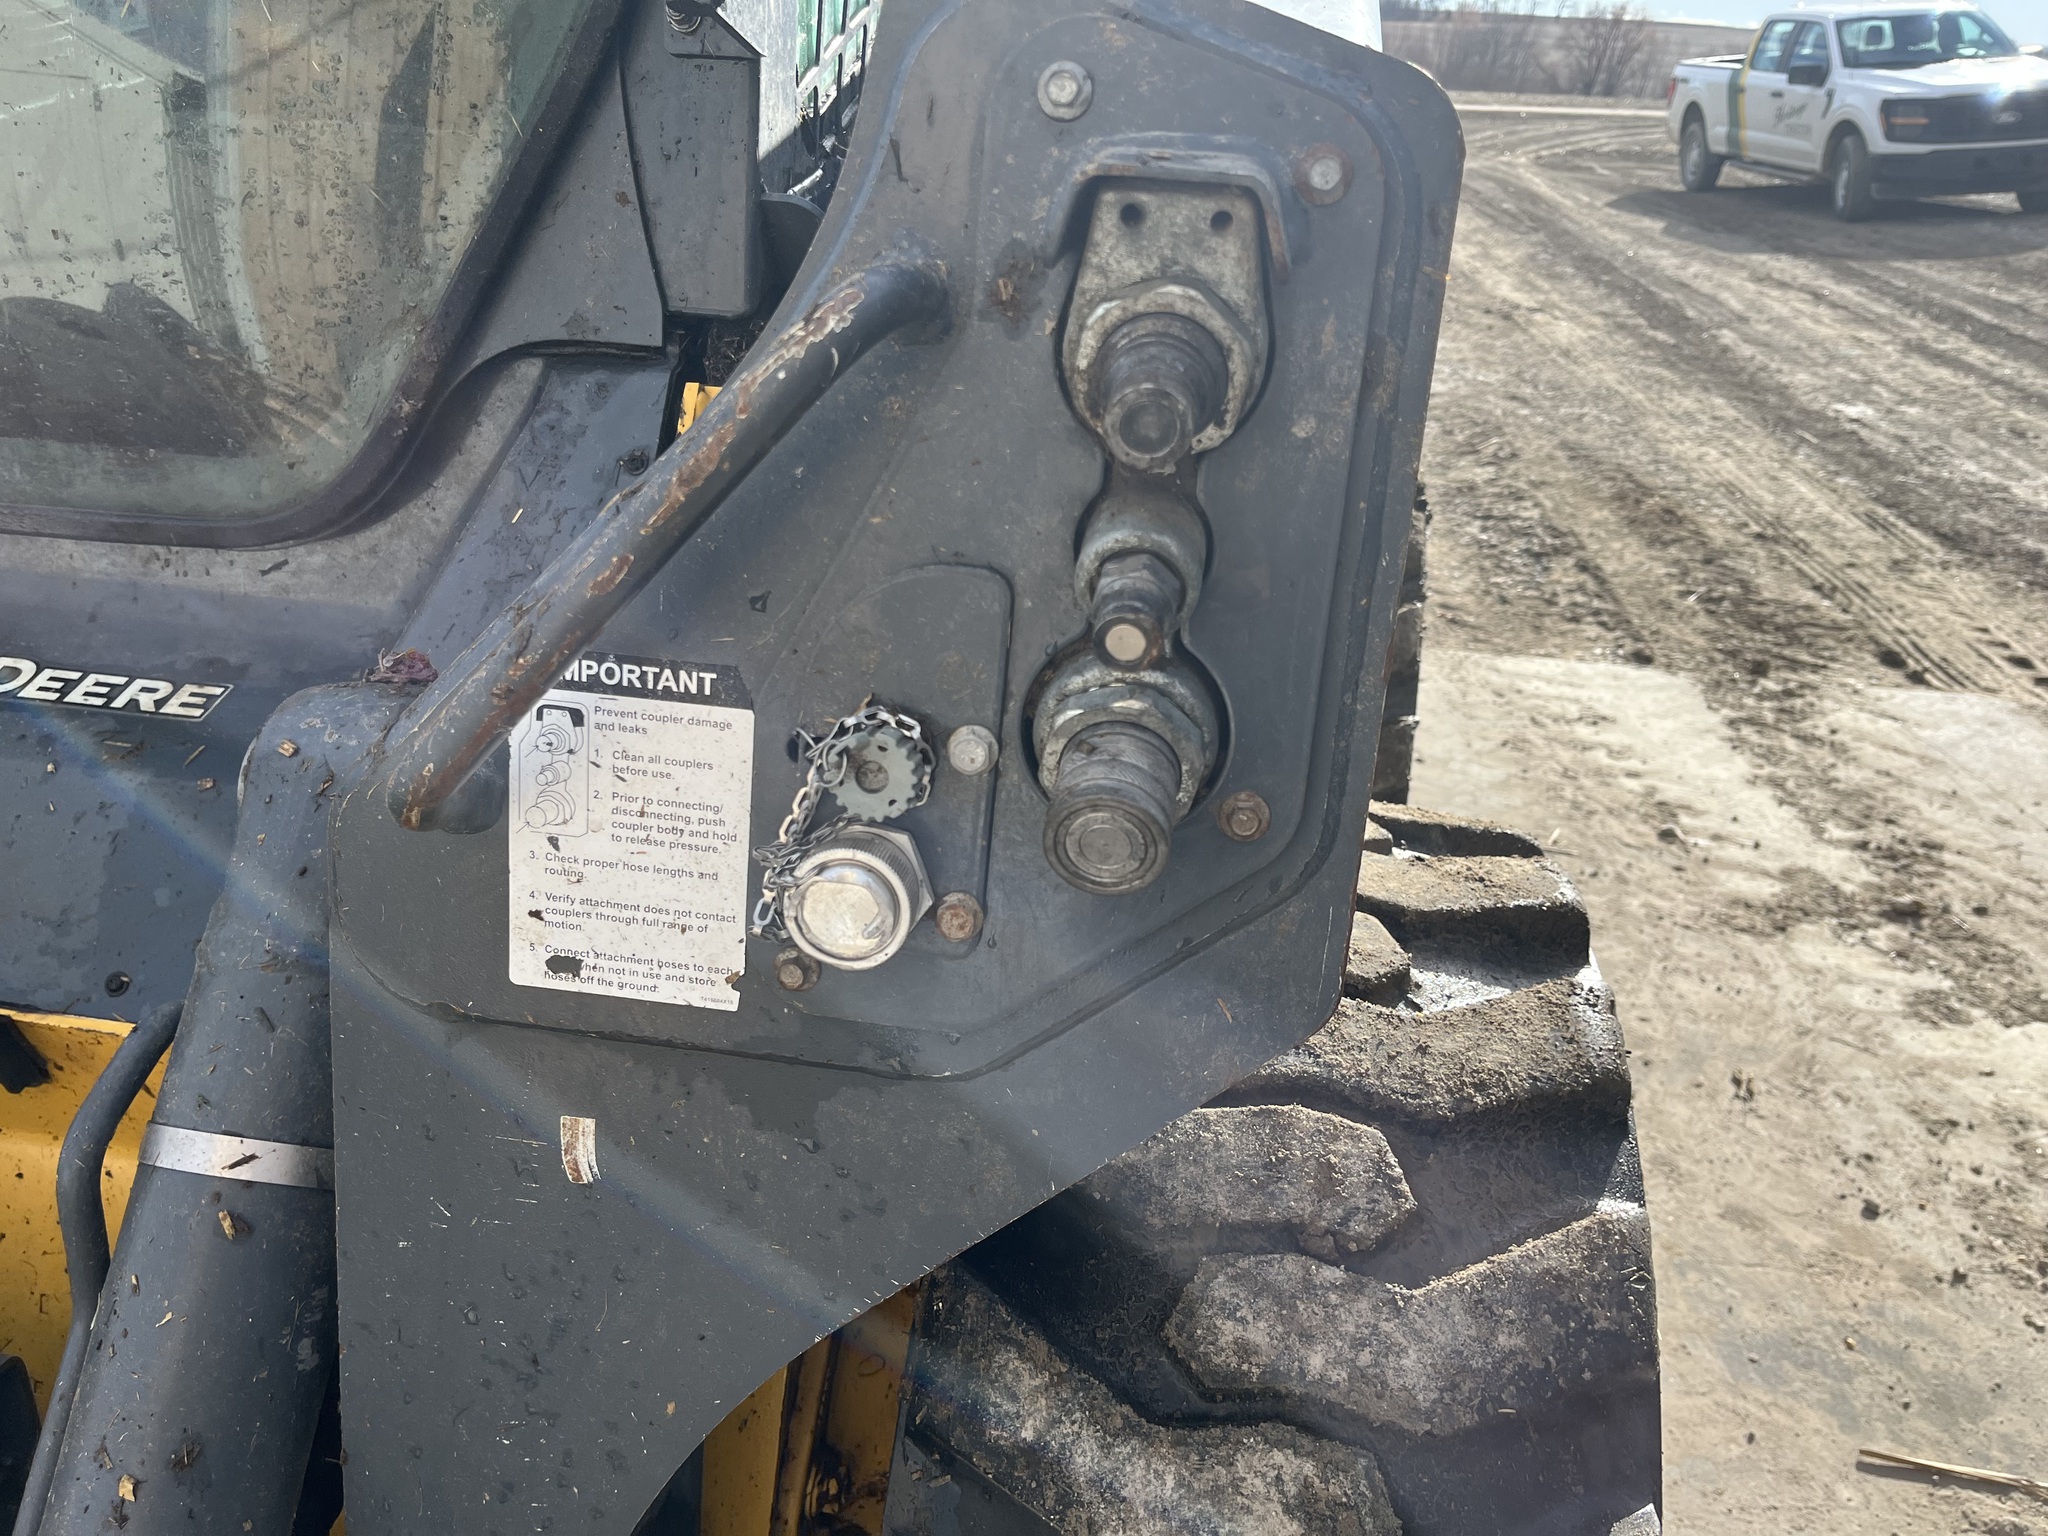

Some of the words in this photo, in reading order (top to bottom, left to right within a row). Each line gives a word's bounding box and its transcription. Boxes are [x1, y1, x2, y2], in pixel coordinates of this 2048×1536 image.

[560, 659, 717, 696] MPORTANT
[594, 706, 637, 720] Prevent
[641, 713, 684, 725] coupler
[687, 717, 733, 732] damage
[594, 722, 615, 731] and
[618, 723, 648, 735] leaks
[594, 750, 603, 758] 1.
[612, 750, 645, 762] Clean
[647, 755, 661, 764] all
[664, 757, 714, 770] couplers
[612, 764, 649, 777] before
[651, 771, 676, 780] use.
[593, 790, 603, 800] 2.
[612, 791, 639, 804] Prior
[642, 796, 654, 805] to
[657, 798, 724, 816] connecting/
[611, 806, 694, 825] disconnecting,
[698, 817, 726, 828] push
[611, 821, 654, 836] coupler
[657, 826, 685, 838] body
[688, 829, 709, 839] and
[712, 830, 737, 842] hold
[611, 833, 622, 843] to
[625, 835, 666, 848] release
[669, 841, 721, 855] pressure.
[529, 850, 539, 860] 3.
[545, 852, 580, 865] Check
[583, 858, 620, 869] proper
[623, 861, 650, 873] hose
[653, 865, 695, 879] lengths
[698, 872, 719, 881] and
[544, 867, 587, 880] routing.
[529, 890, 539, 900] 4.
[544, 892, 576, 906] Verify
[579, 897, 640, 912] attachment
[643, 904, 671, 916] does
[674, 909, 692, 918] not
[695, 911, 736, 924] contact
[544, 920, 585, 932] motion.
[545, 907, 592, 919] couplers
[595, 911, 639, 927] through
[642, 917, 659, 927] full
[697, 924, 709, 933] of
[529, 943, 538, 952] 5.
[544, 944, 590, 959] Connect
[593, 951, 654, 967] attachment
[693, 963, 704, 972] to
[707, 966, 733, 976] each
[544, 971, 577, 983] hoses
[580, 975, 595, 985] off
[597, 978, 615, 988] the
[617, 980, 660, 993] ground.
[608, 967, 626, 976] not
[629, 968, 639, 977] in
[642, 972, 662, 980] use
[665, 974, 685, 983] and
[688, 976, 717, 987] store
